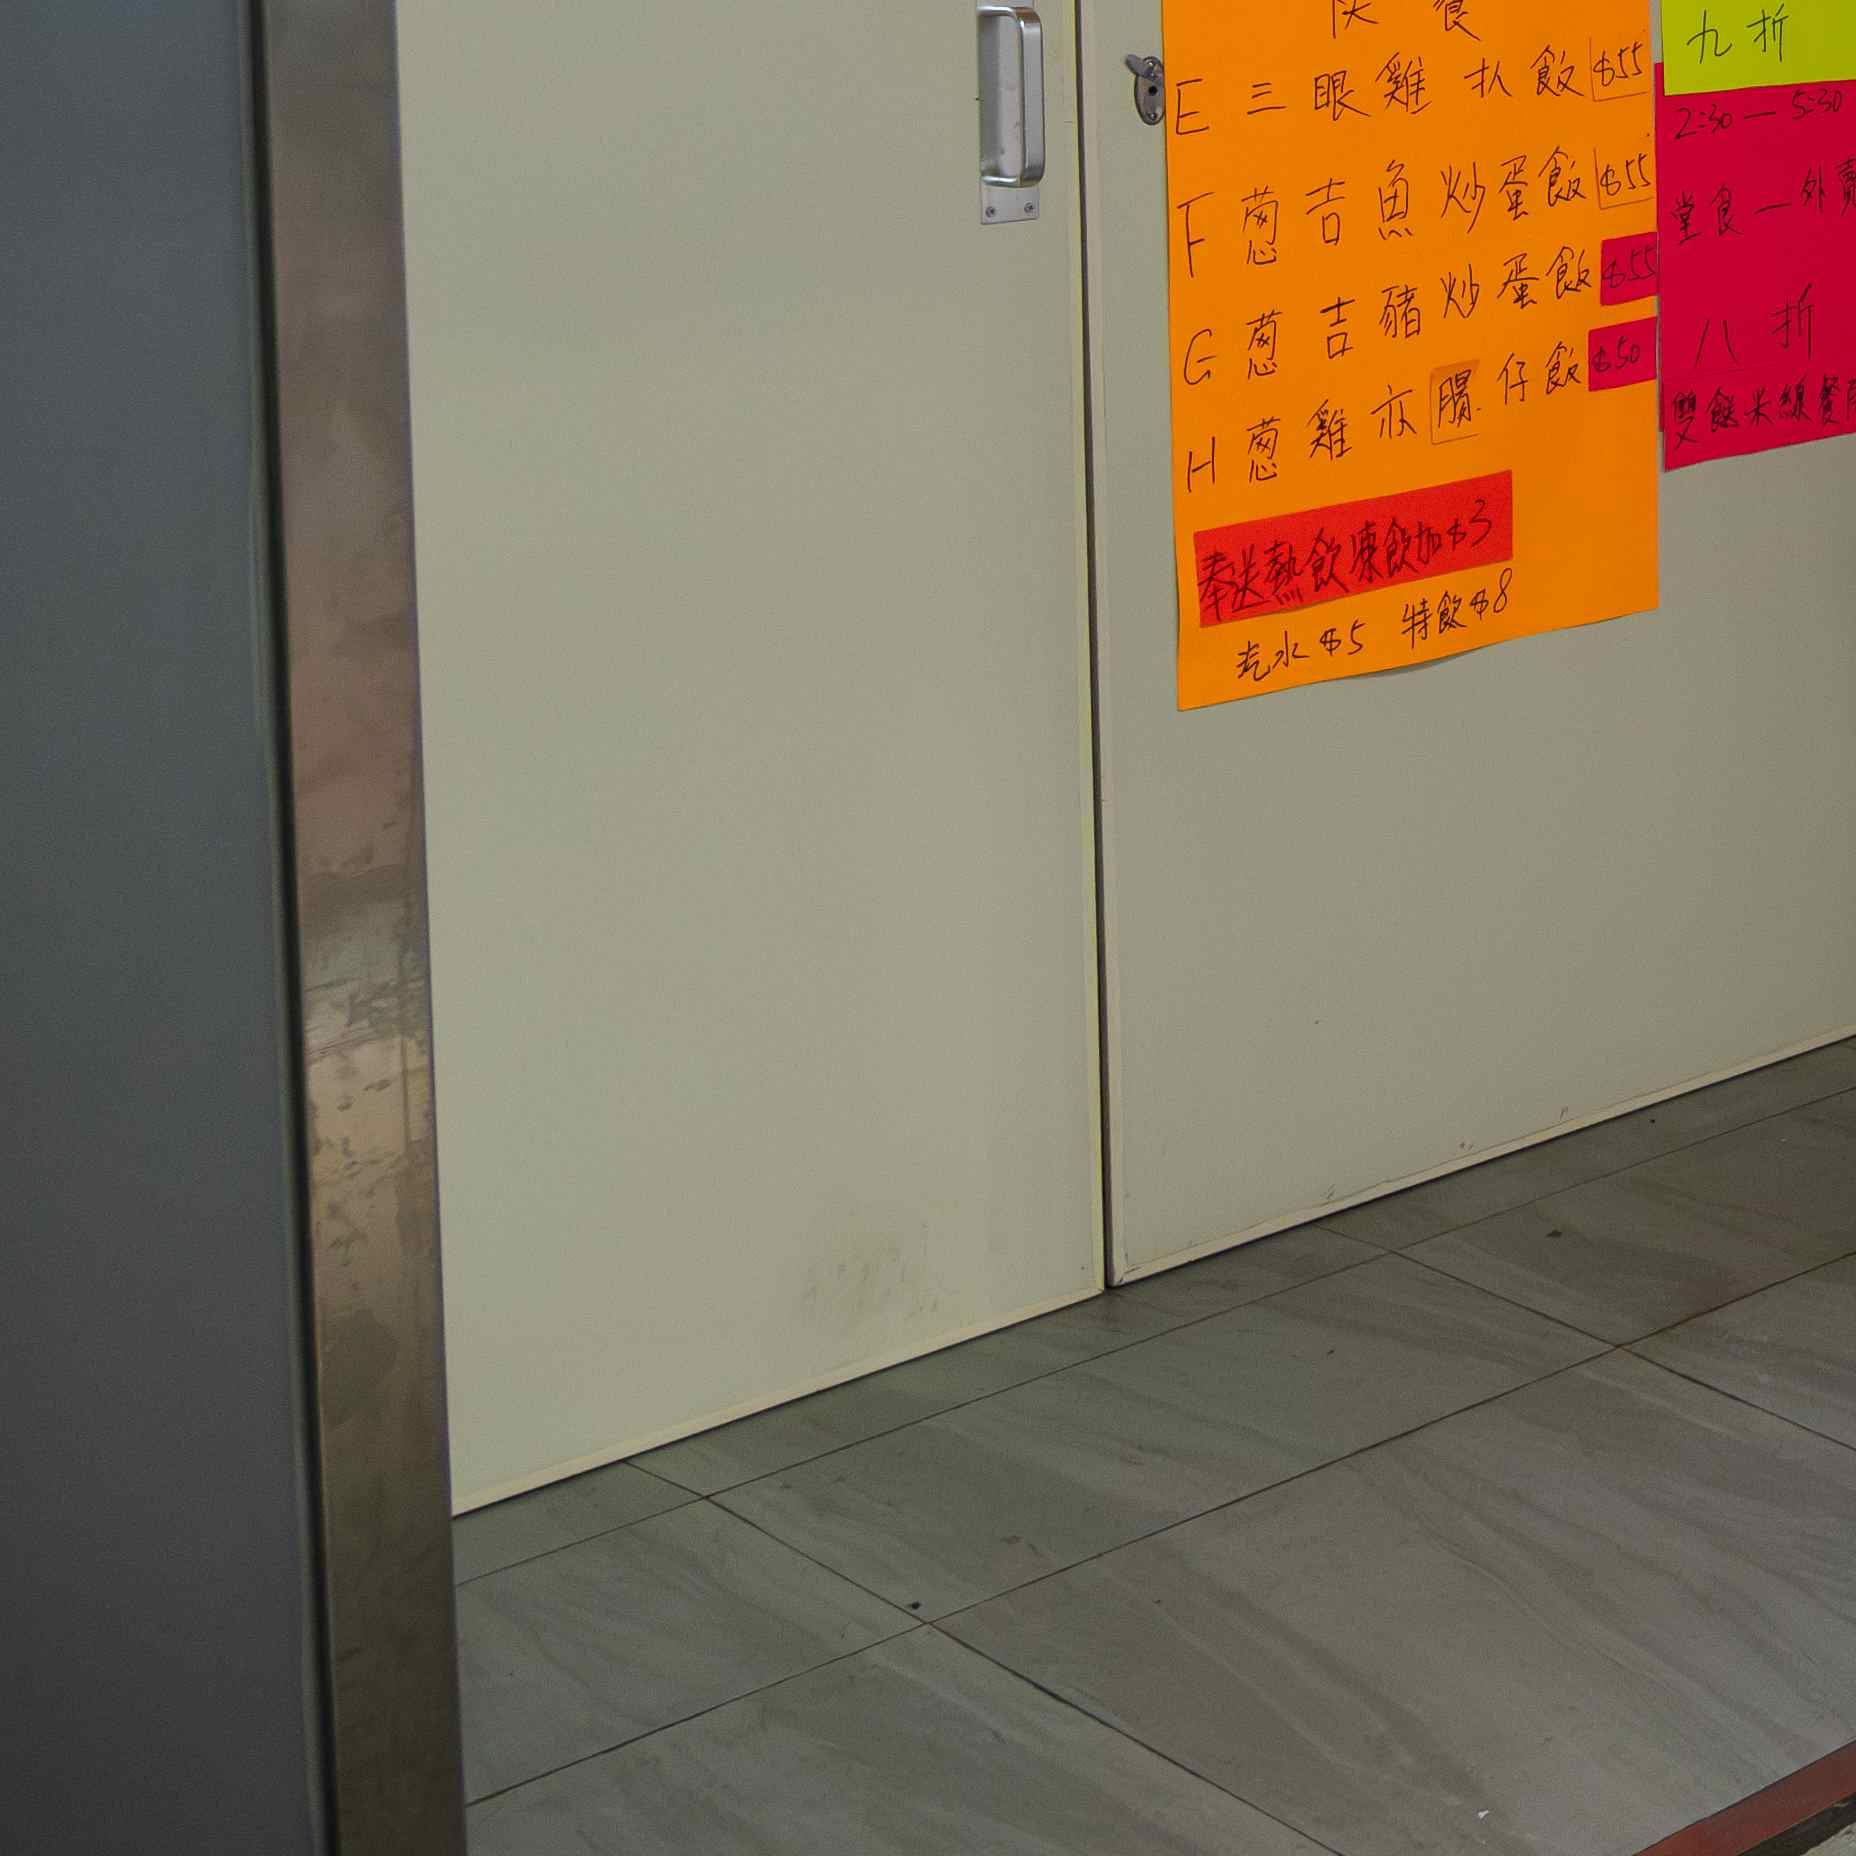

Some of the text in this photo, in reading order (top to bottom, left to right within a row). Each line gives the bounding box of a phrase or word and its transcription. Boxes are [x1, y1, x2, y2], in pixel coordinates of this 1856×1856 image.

[1687, 3, 1789, 66] 九折
[1176, 78, 1210, 136] E
[1593, 41, 1645, 89] $55
[1177, 192, 1215, 278] F
[1599, 152, 1651, 195] $55
[1184, 329, 1218, 386] G
[1695, 284, 1814, 369] 八折
[1186, 438, 1217, 492] H
[1593, 341, 1641, 373] $50
